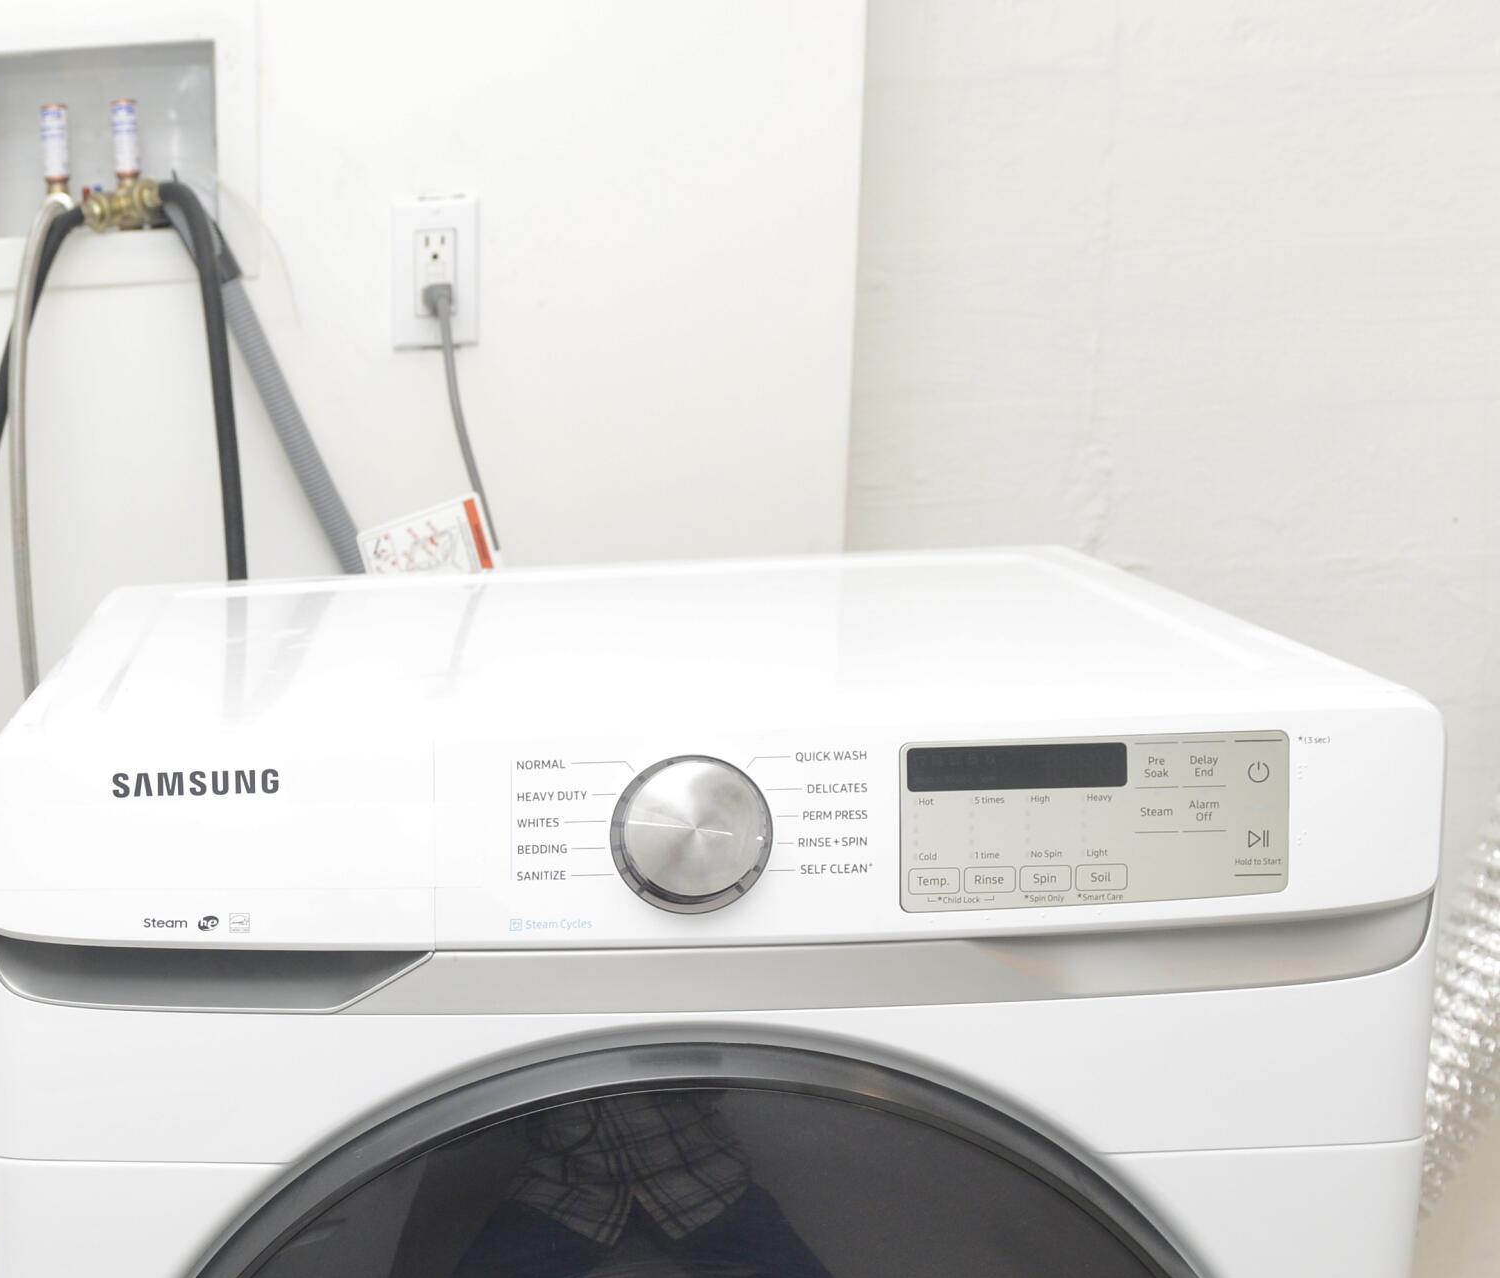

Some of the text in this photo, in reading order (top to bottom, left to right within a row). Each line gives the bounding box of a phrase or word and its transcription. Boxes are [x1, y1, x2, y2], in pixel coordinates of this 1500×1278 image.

[795, 751, 867, 763] QUICK WASH
[1148, 756, 1165, 766] Pre
[1190, 755, 1218, 767] Delay
[516, 760, 566, 770] NORMAL
[1144, 769, 1169, 778] Soak
[1195, 767, 1214, 777] End
[112, 768, 280, 799] SAMSUNG
[807, 783, 868, 793] DELICATES
[517, 791, 587, 802] HEAVY DUTY
[981, 796, 1005, 804] times
[1031, 795, 1050, 804] High
[1086, 794, 1113, 802] Heavy
[919, 798, 933, 806] Hot
[1189, 800, 1220, 810] Alarm
[802, 810, 868, 820] PERM PRESS
[1140, 807, 1173, 817] Steam
[1196, 812, 1213, 822] Off
[517, 818, 560, 828] WHITES
[798, 838, 832, 847] RINSE
[841, 837, 868, 846] SPIN
[517, 844, 568, 855] BEDDING
[1031, 850, 1062, 859] No Spin
[1086, 849, 1108, 858] Light
[919, 853, 937, 861] Cold
[981, 851, 1000, 859] time
[1234, 858, 1252, 866] Hold
[800, 864, 827, 874] SELF
[517, 870, 567, 881] SANITIZE
[974, 875, 1004, 885] Rinse
[1033, 873, 1057, 885] Spin
[1091, 872, 1111, 882] Soil
[917, 876, 949, 887] Temp.
[963, 895, 980, 903] Lock
[1047, 894, 1064, 903] Only
[1106, 892, 1124, 901] Care
[143, 918, 188, 929] Steam
[526, 919, 593, 930] Steam Cycles
